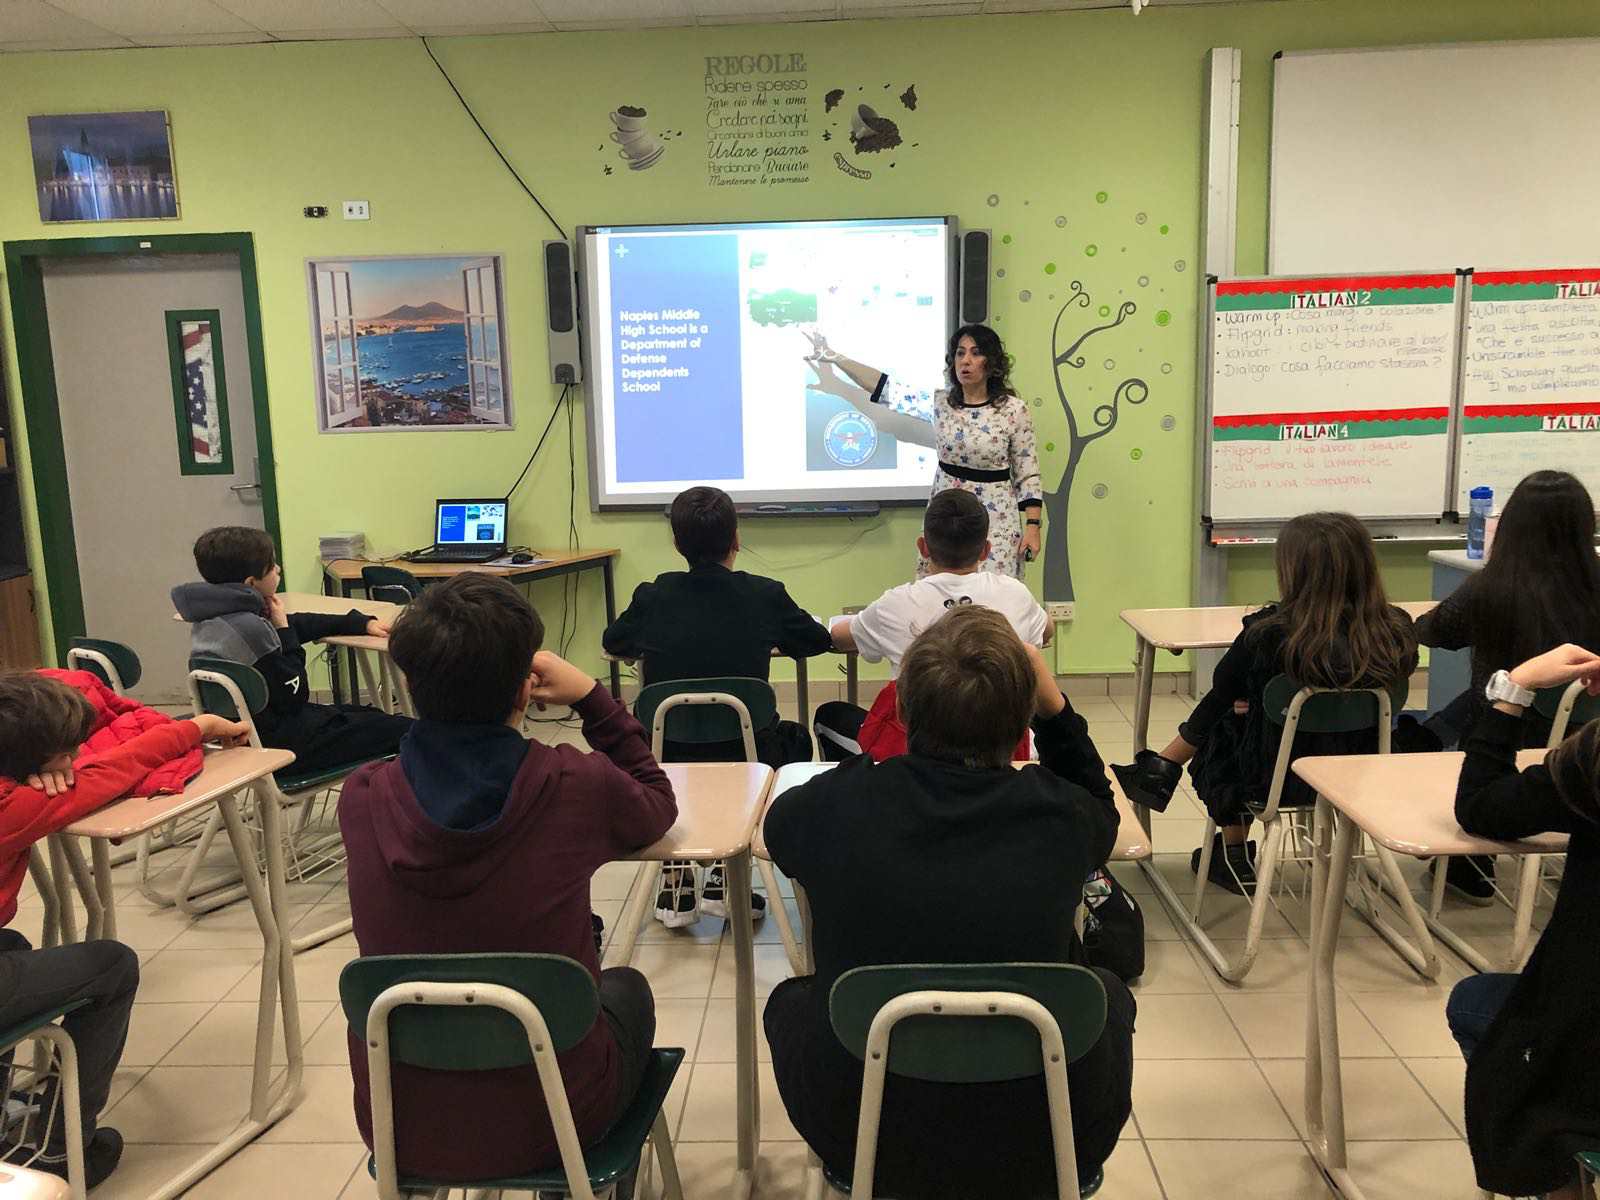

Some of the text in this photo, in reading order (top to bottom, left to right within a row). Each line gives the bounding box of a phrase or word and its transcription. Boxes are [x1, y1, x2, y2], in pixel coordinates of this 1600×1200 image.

[705, 54, 807, 75] REGOLE
[705, 76, 808, 97] Ridere spesso
[707, 140, 809, 163] Urlare piano
[1292, 291, 1371, 309] ITALIAN 2
[620, 309, 700, 323] Naples Middle
[621, 323, 709, 337] High School is a
[621, 337, 701, 352] Department of
[622, 354, 667, 364] Defense
[622, 367, 689, 380] Dependents
[623, 381, 660, 392] School
[1281, 424, 1349, 440] ITALIAN 4
